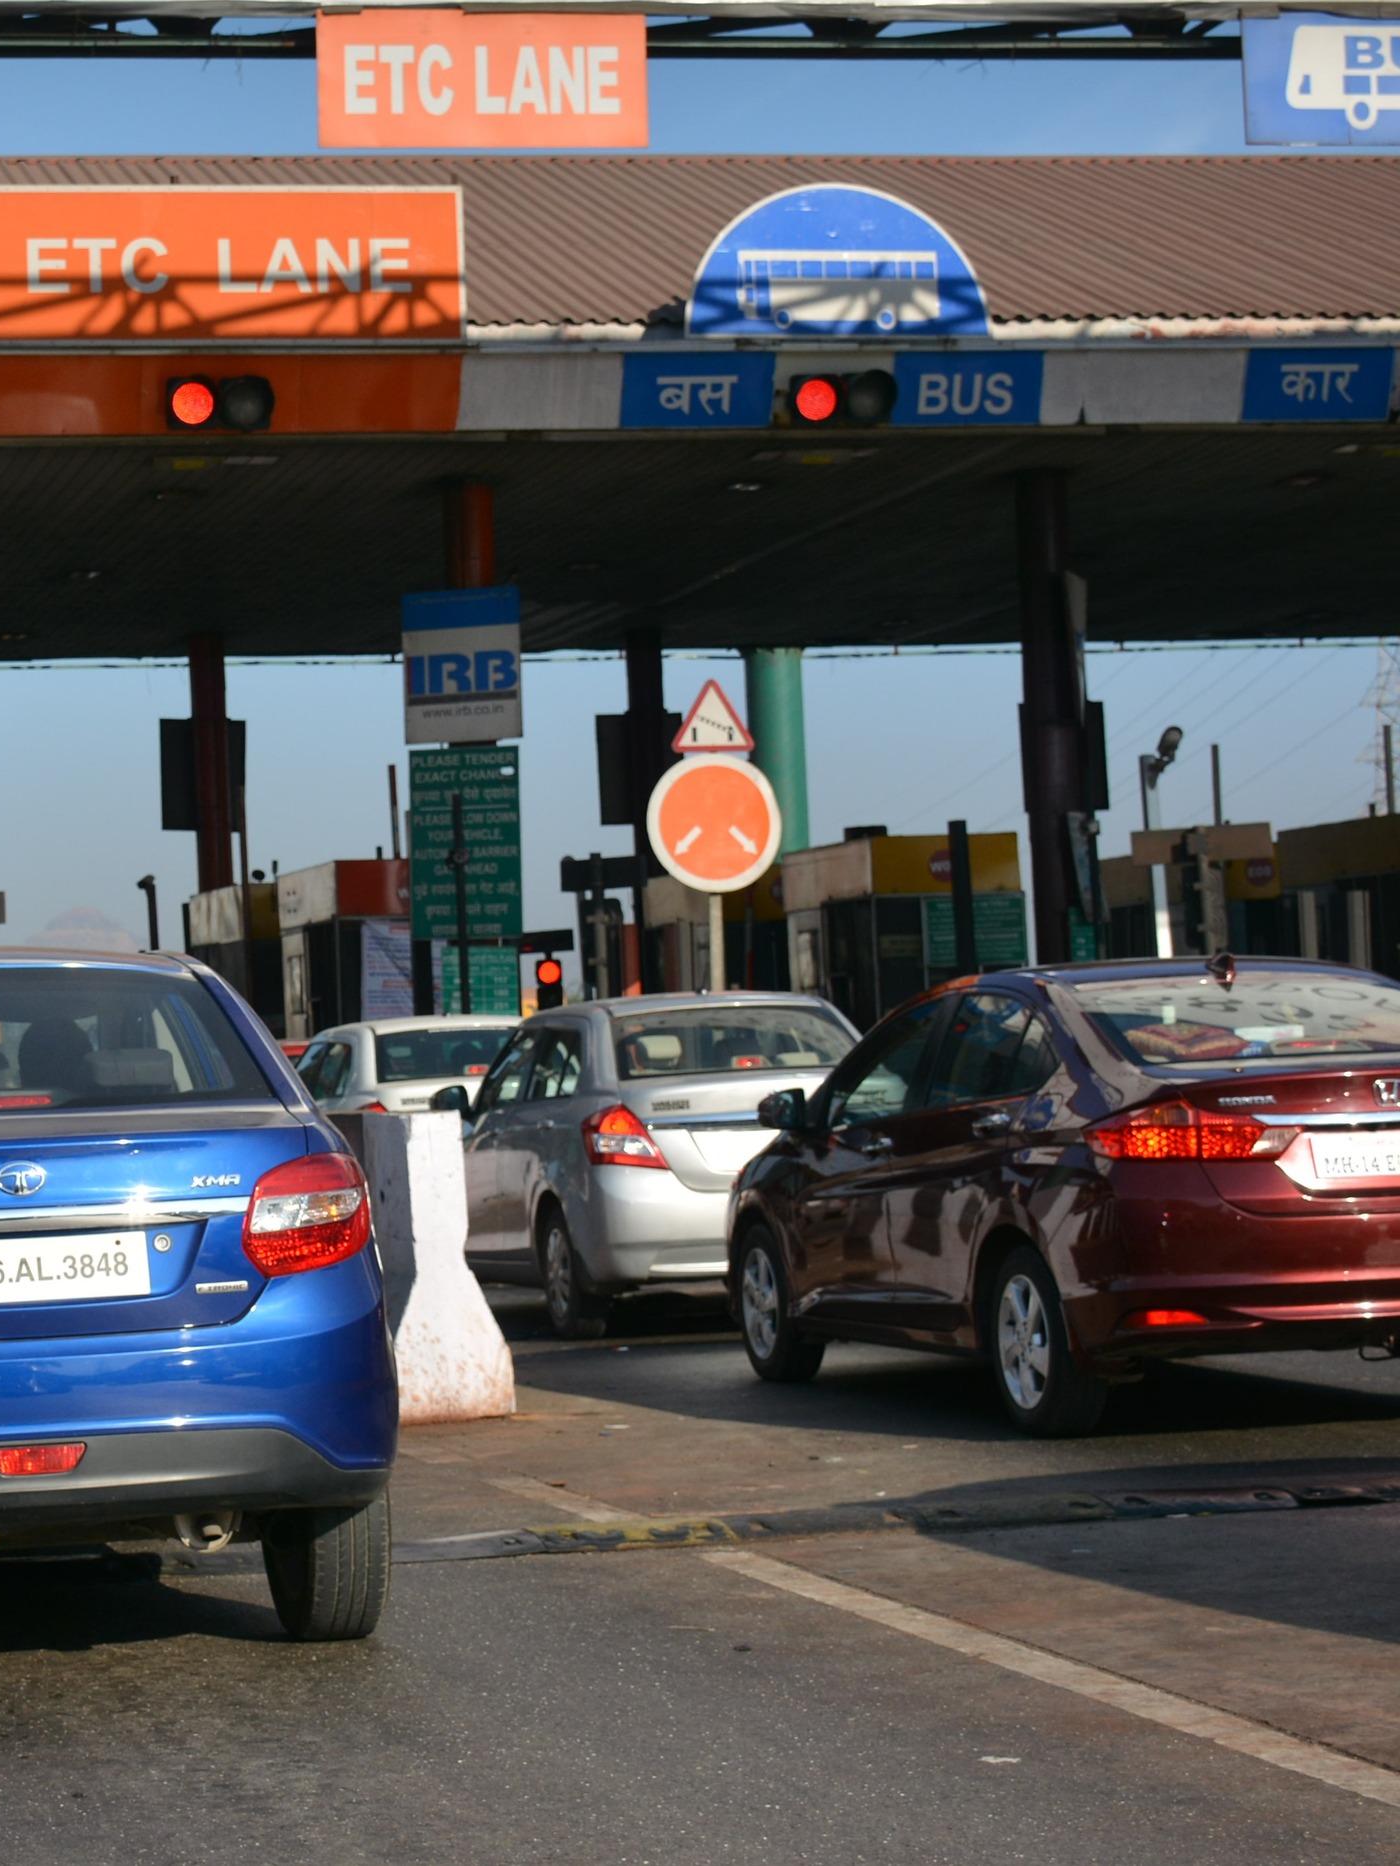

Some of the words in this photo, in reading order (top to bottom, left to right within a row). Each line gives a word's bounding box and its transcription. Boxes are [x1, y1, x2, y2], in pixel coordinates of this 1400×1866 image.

[1344, 35, 1400, 70] B
[343, 44, 454, 116] ETC
[474, 45, 621, 115] LANE
[25, 236, 169, 295] ETC
[216, 237, 413, 294] LANE
[656, 374, 738, 415] बस
[917, 372, 1014, 416] BUS
[1280, 363, 1360, 405] कार
[405, 649, 518, 697] IRB
[411, 753, 461, 769] PLEASE
[464, 751, 516, 765] TENDER
[414, 770, 457, 785] EXACT
[459, 768, 513, 782] CHANG
[1218, 1094, 1277, 1107] HONDA
[190, 1173, 241, 1188] XMA
